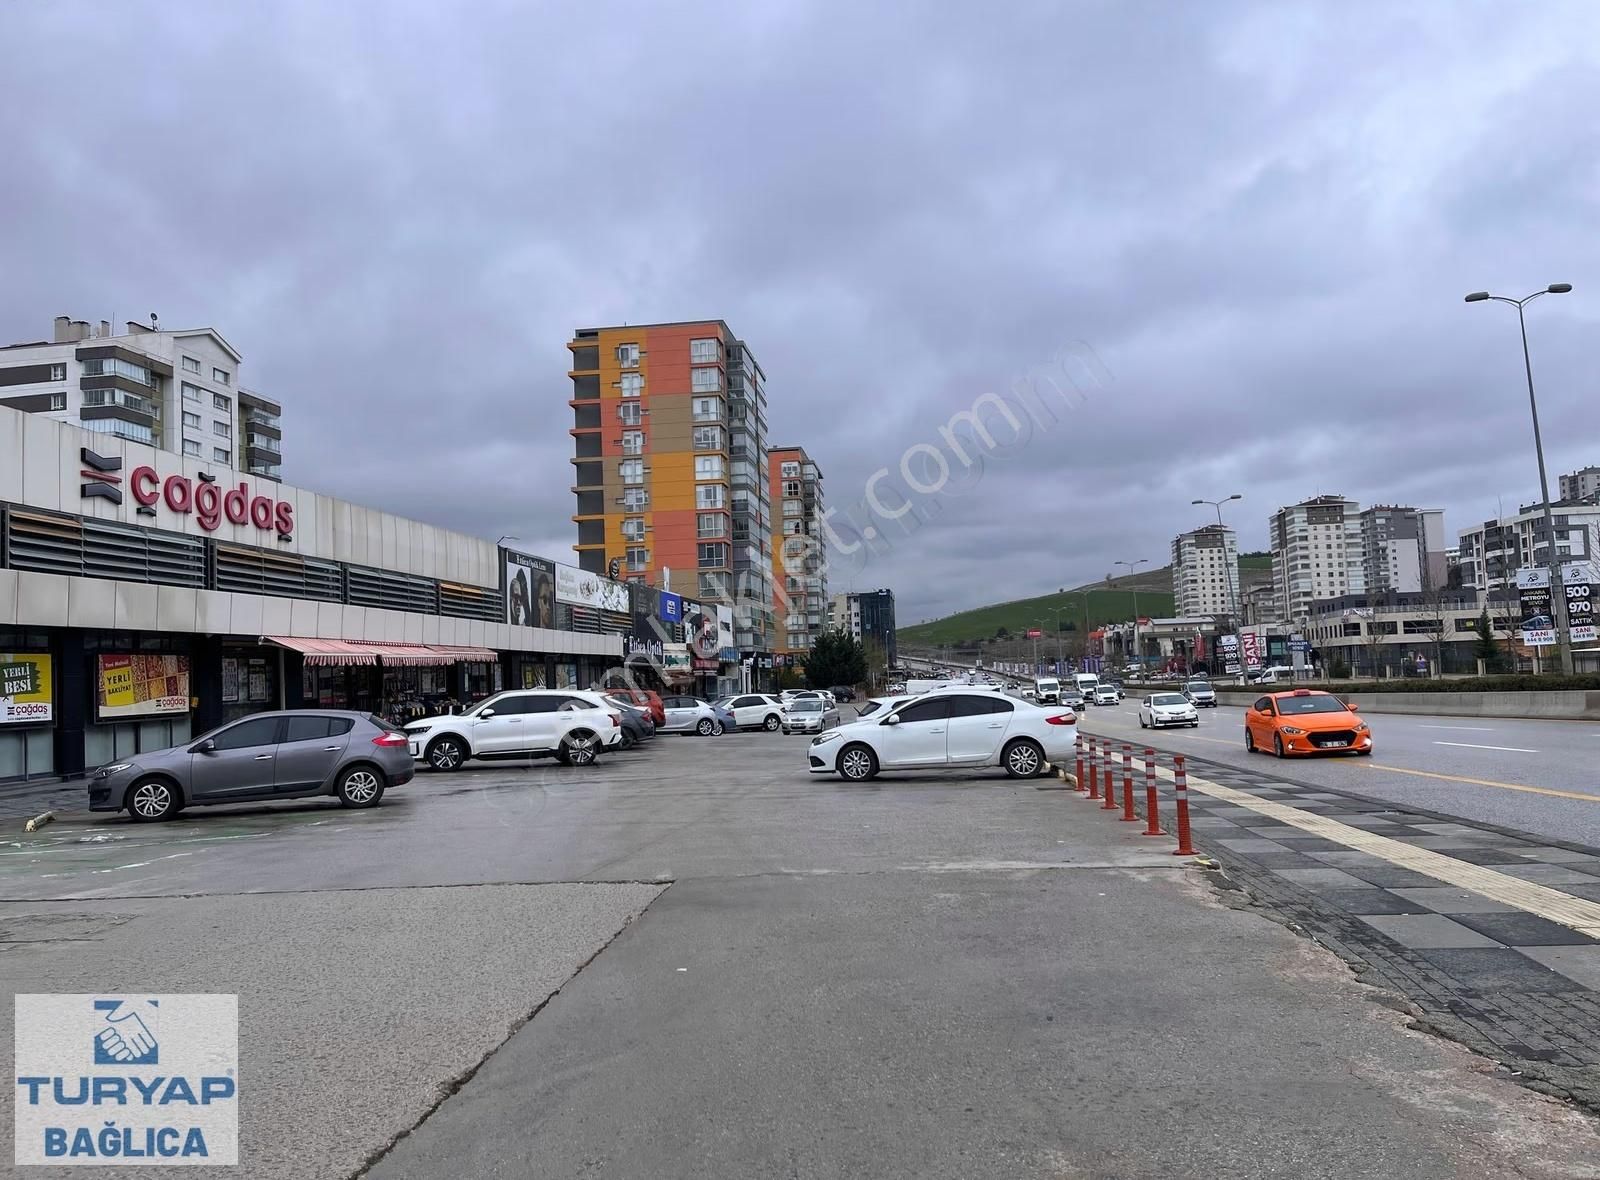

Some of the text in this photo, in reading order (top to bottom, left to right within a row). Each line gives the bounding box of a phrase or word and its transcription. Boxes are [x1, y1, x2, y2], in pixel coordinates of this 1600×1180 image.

[130, 466, 293, 542] çağdaş
[1566, 585, 1590, 598] 500
[1568, 601, 1591, 613] 970
[646, 638, 663, 660] Optik
[1243, 634, 1259, 664] SANİ
[3, 662, 30, 678] YERLİ
[106, 670, 130, 685] YERLİ
[4, 675, 32, 694] BESİ
[16, 704, 48, 715] çağdaş
[162, 697, 186, 707] çağdaş
